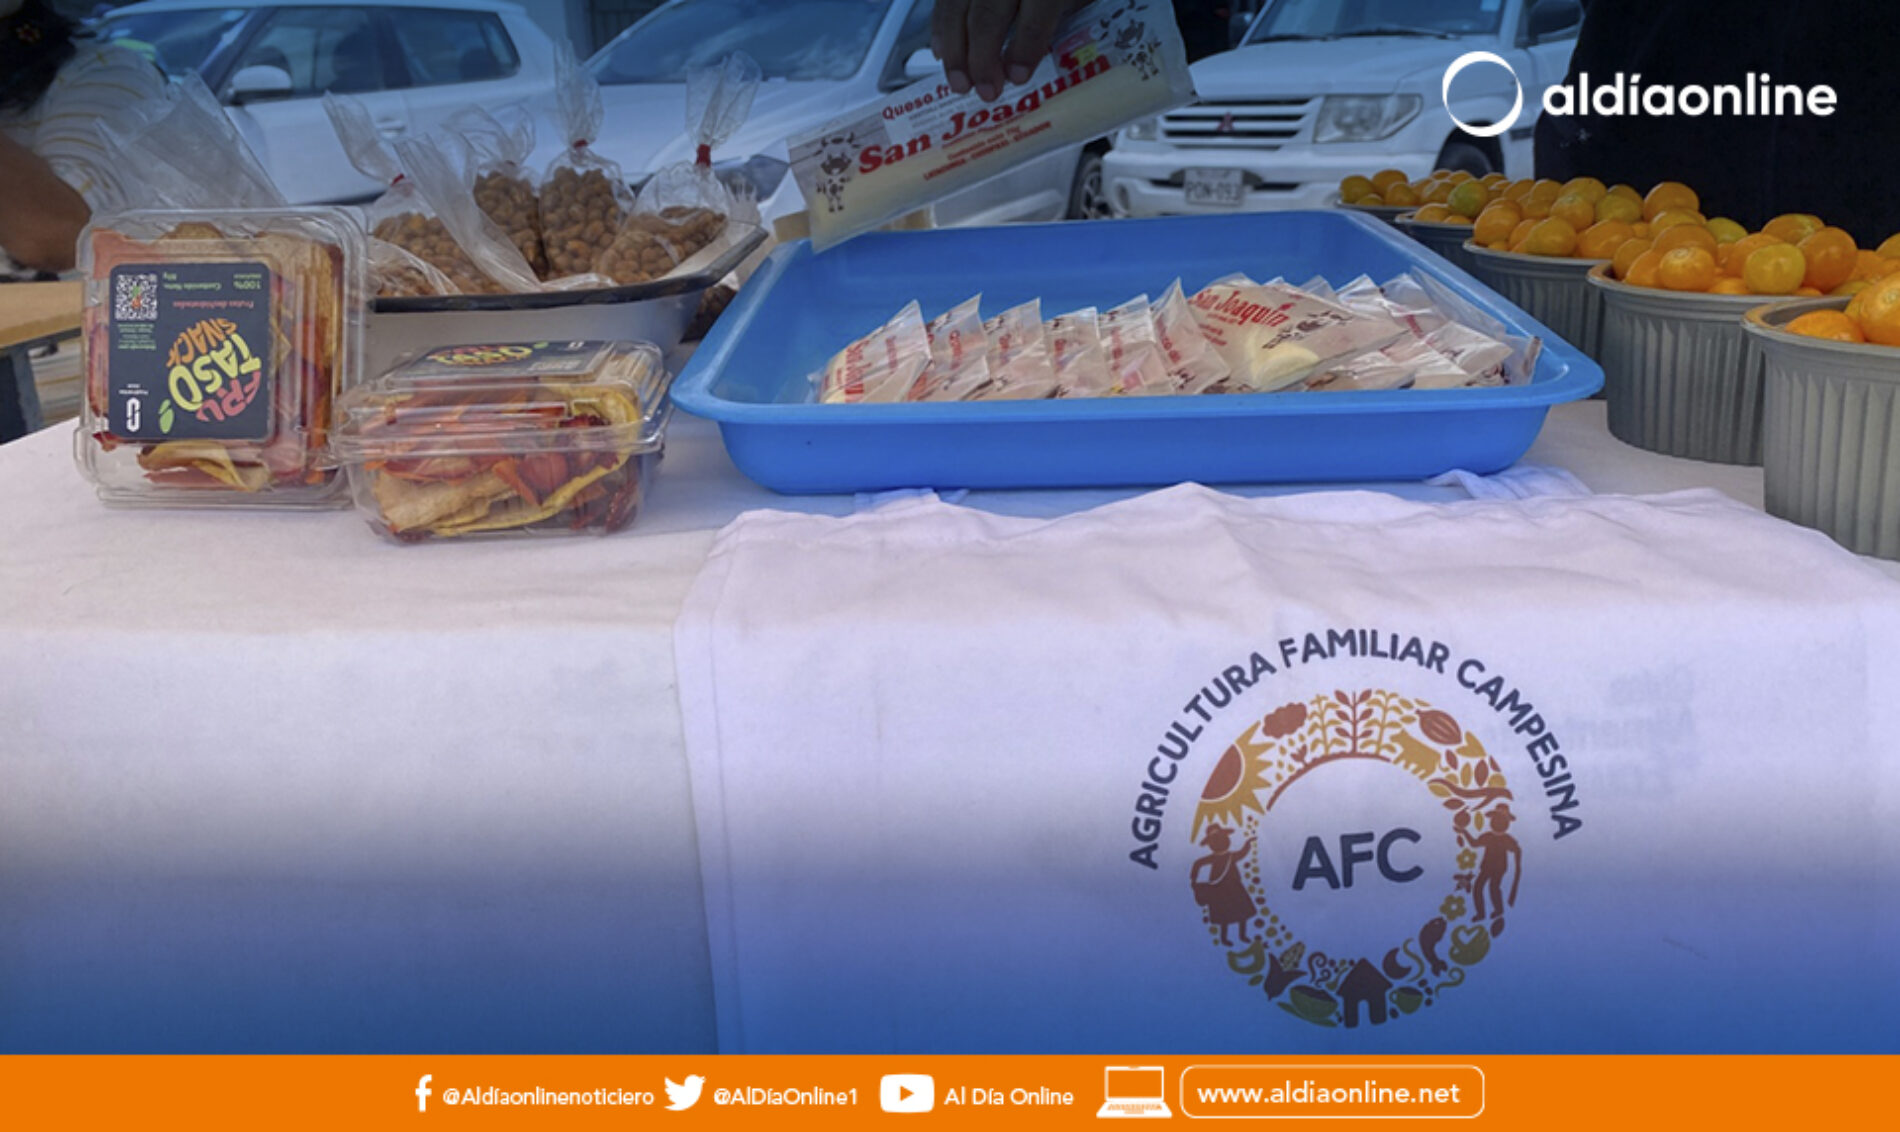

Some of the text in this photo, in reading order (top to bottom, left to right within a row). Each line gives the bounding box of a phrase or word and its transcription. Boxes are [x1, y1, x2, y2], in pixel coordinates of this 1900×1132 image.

[882, 93, 933, 121] Queso
[858, 134, 931, 175] San
[233, 281, 261, 290] 100%
[166, 318, 237, 367] SNACK
[168, 332, 261, 411] TASO
[196, 370, 261, 422] FRU
[1129, 628, 1583, 870] AGRICULTURA FAMILIAR CAMPESINA
[1291, 827, 1424, 892] AFC
